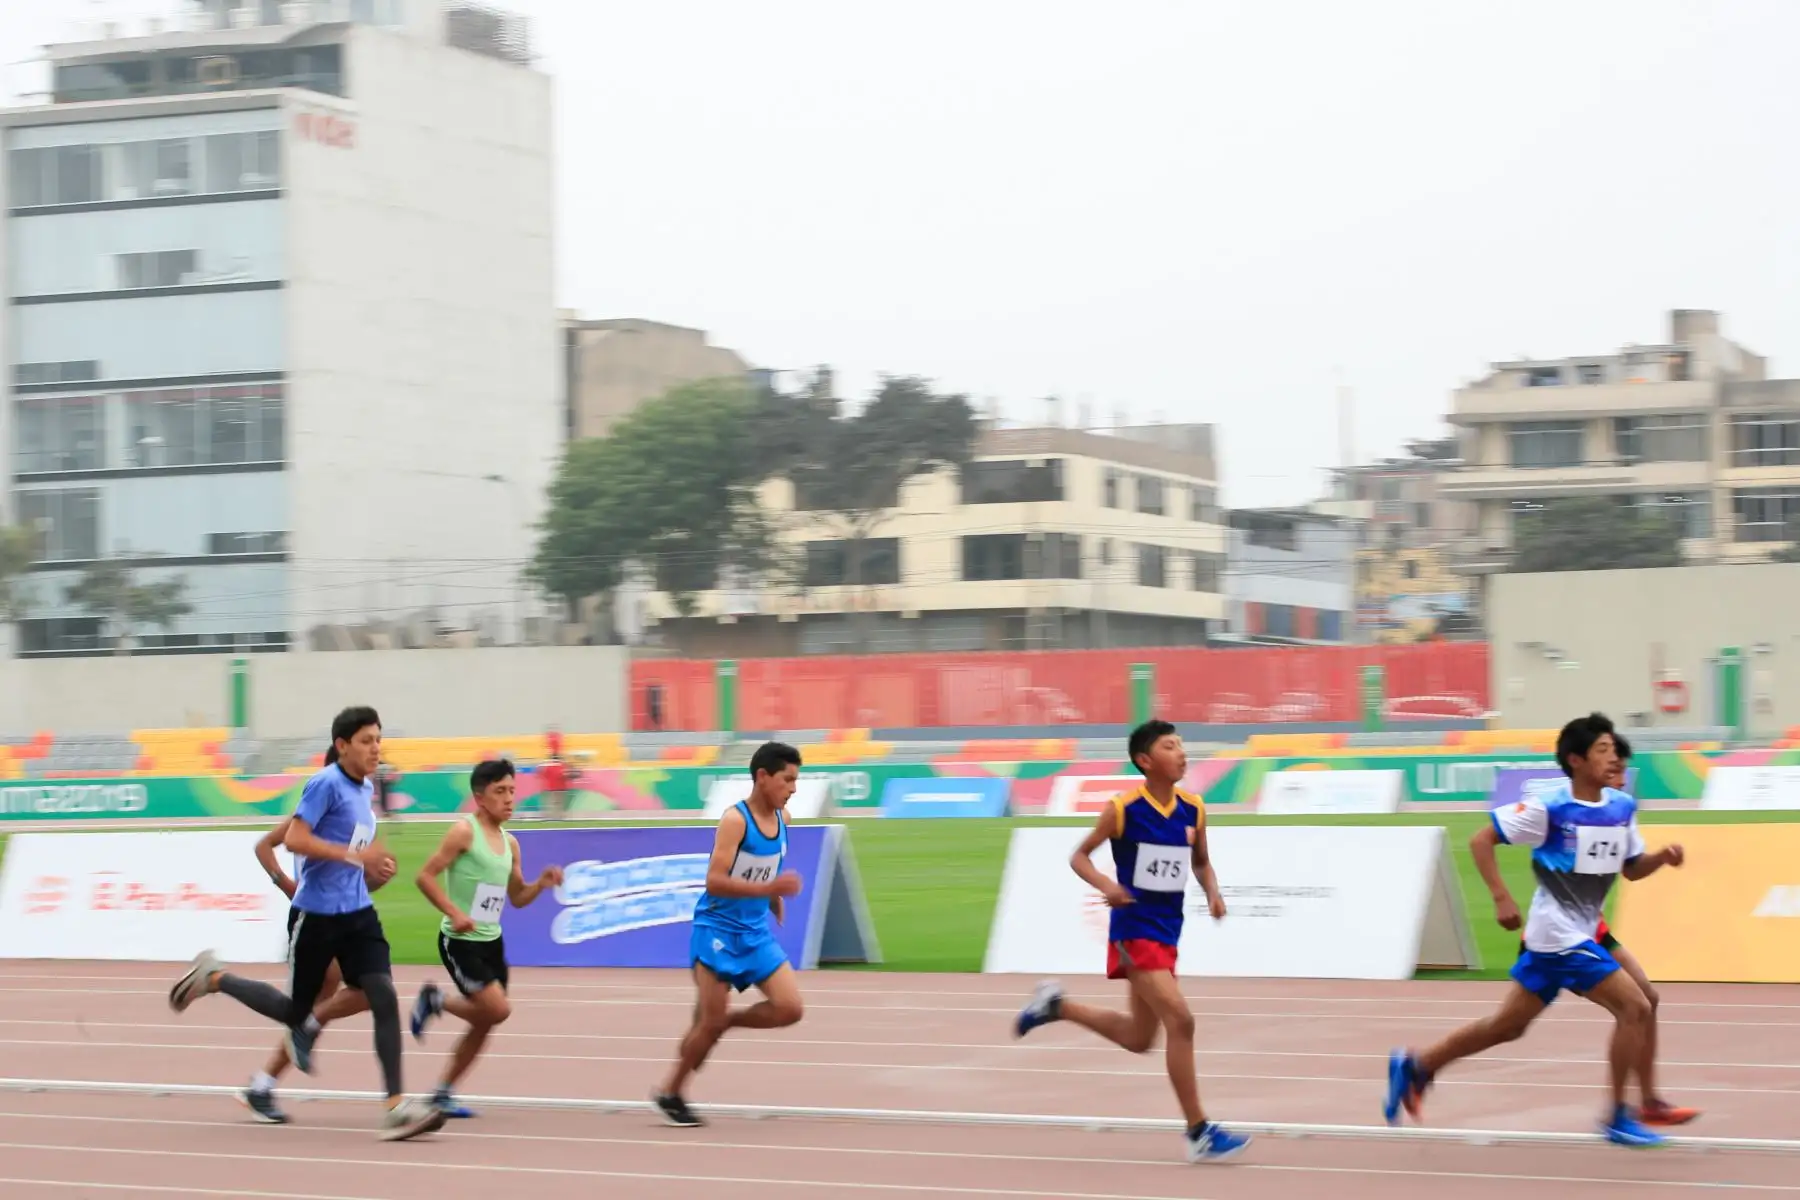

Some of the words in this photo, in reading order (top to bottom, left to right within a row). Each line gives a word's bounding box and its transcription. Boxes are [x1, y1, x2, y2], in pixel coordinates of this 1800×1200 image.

[1587, 841, 1619, 860] 474
[741, 866, 772, 882] 478
[1146, 860, 1182, 879] 475
